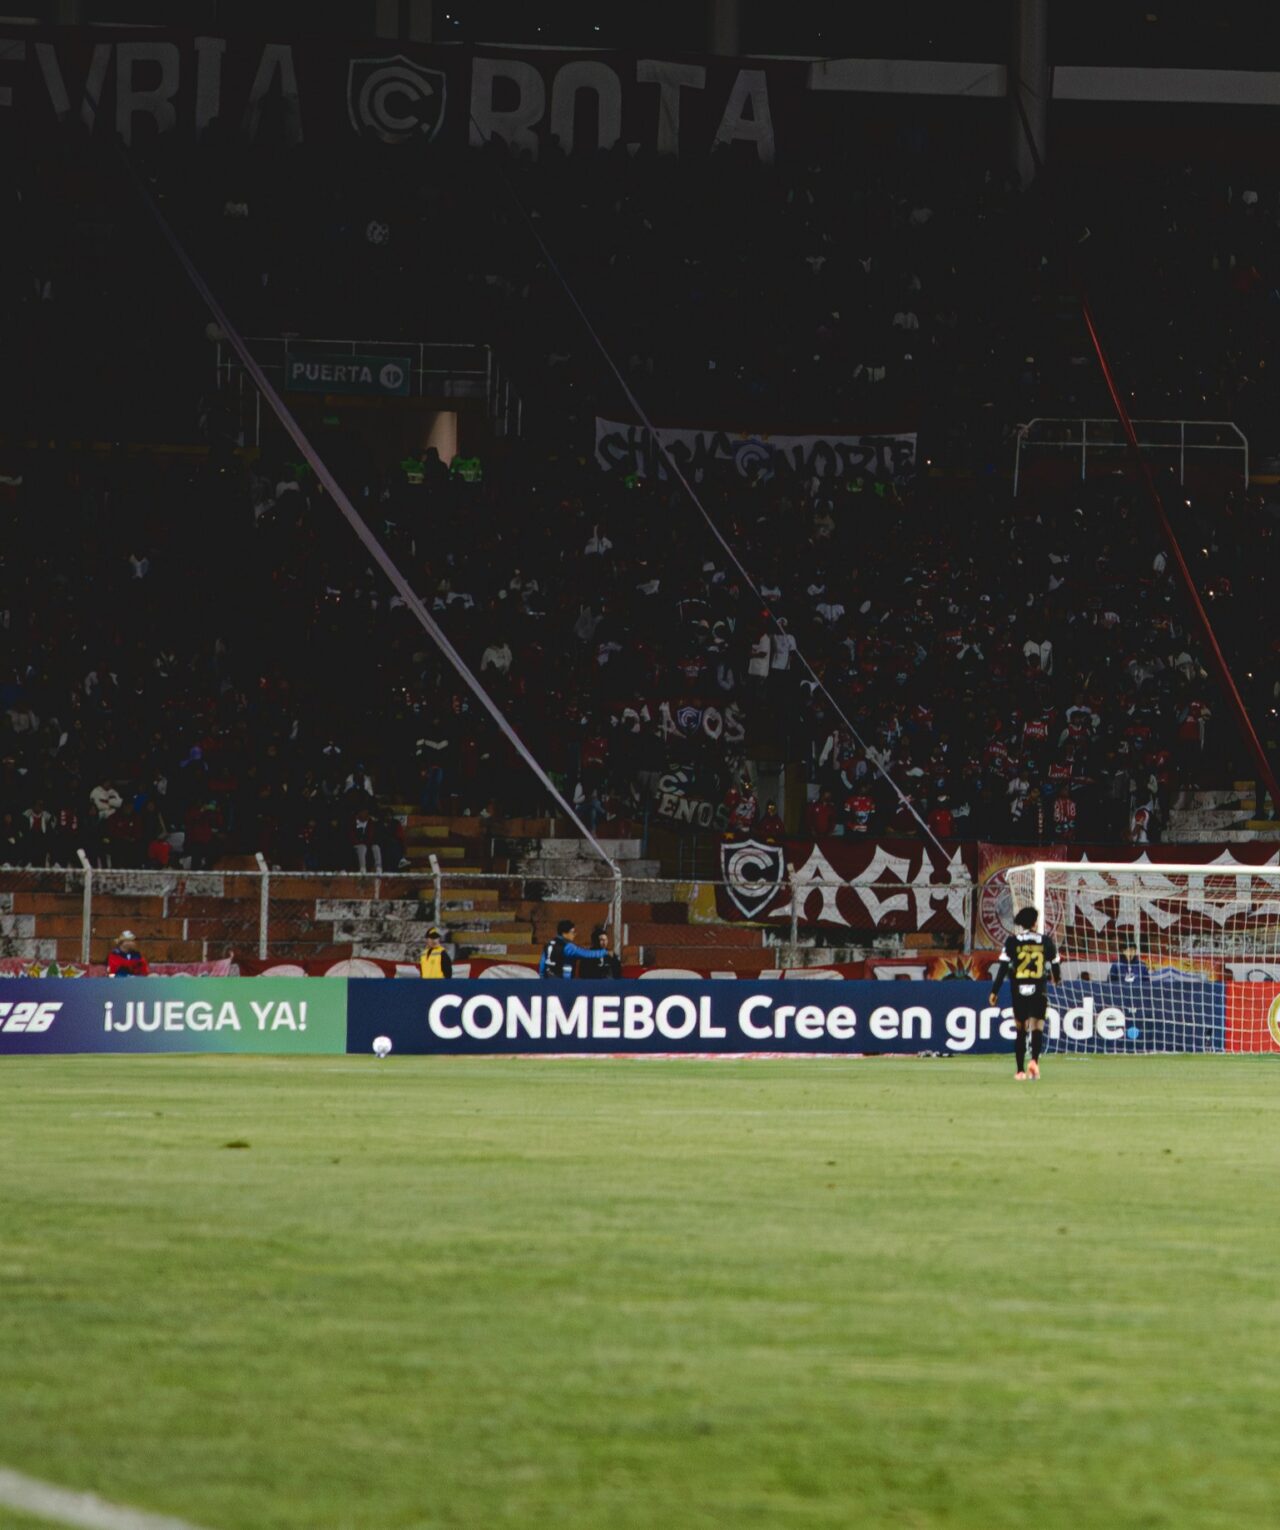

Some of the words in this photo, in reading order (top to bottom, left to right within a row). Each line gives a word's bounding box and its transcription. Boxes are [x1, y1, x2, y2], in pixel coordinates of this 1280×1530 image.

[291, 362, 373, 383] PUERTA
[1016, 951, 1044, 979] 23
[104, 1001, 241, 1032] ¡JUEGA
[249, 1001, 308, 1031] YA!
[428, 994, 727, 1040] CONMEBOL
[738, 995, 857, 1039] Cree
[869, 1006, 932, 1039] en
